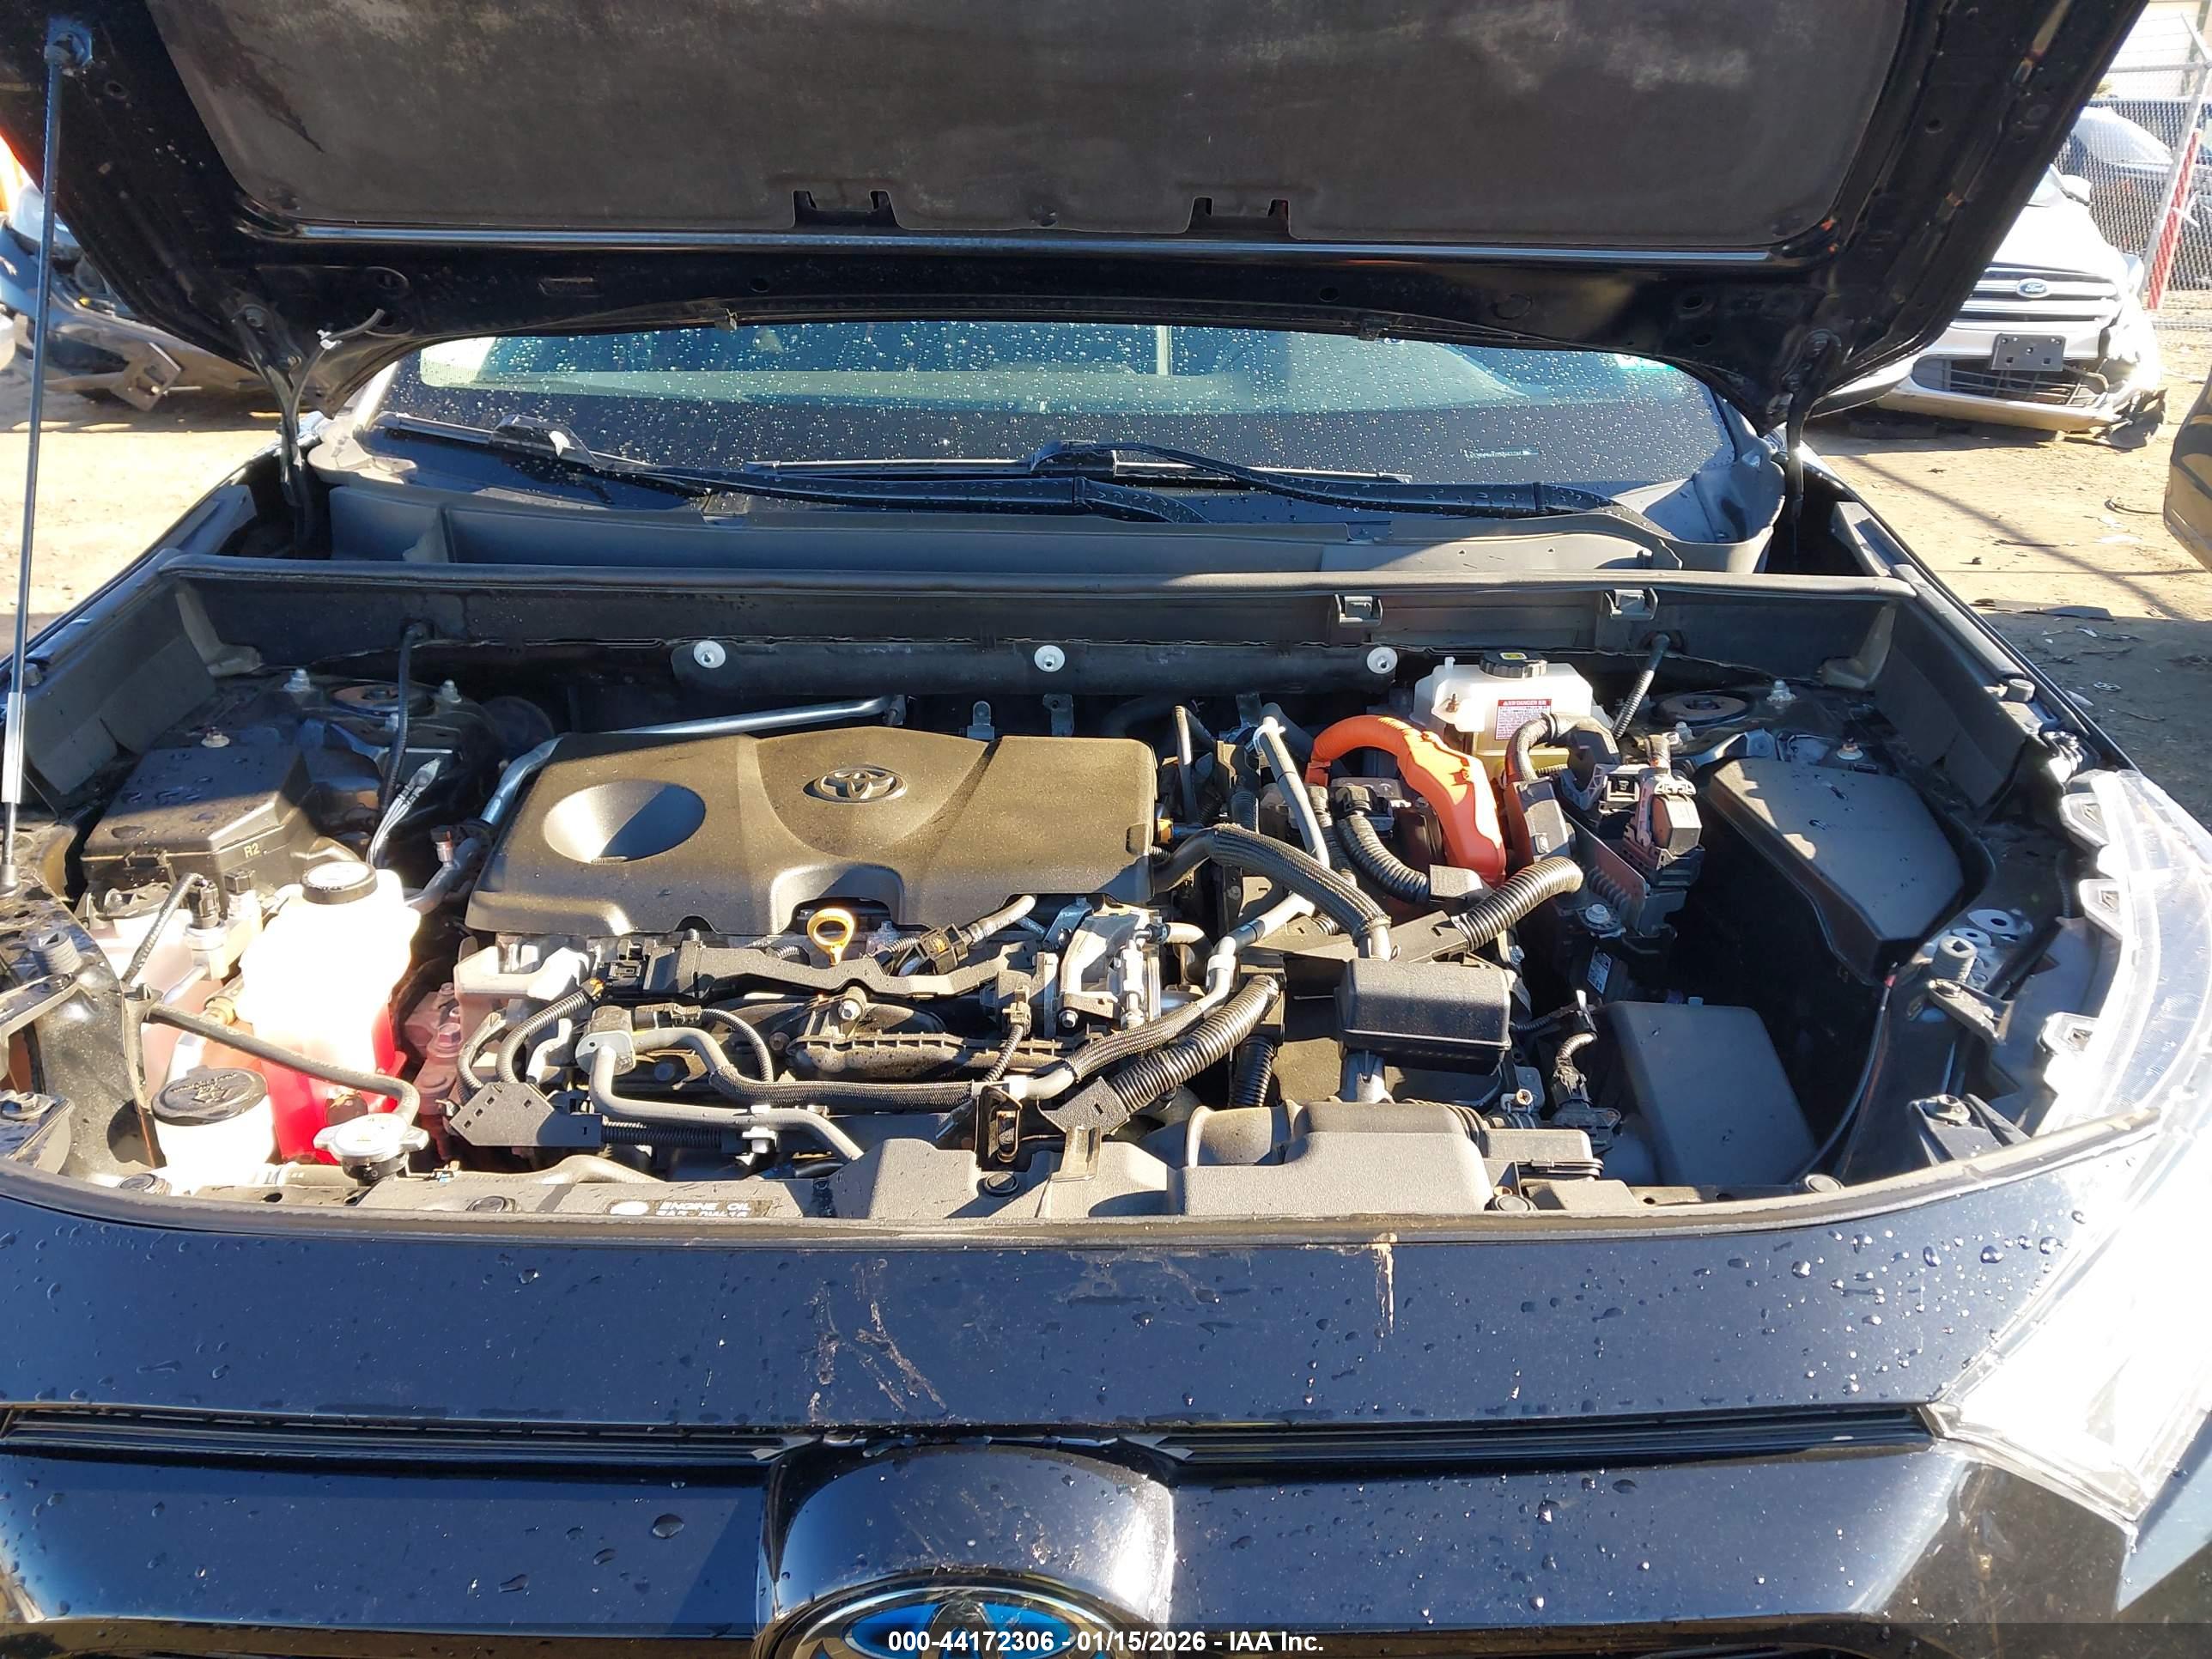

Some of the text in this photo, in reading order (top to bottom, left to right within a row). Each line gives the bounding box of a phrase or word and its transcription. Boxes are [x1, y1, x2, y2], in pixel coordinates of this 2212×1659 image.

[244, 842, 260, 859] R2
[659, 1201, 751, 1211] ENGINE OIL
